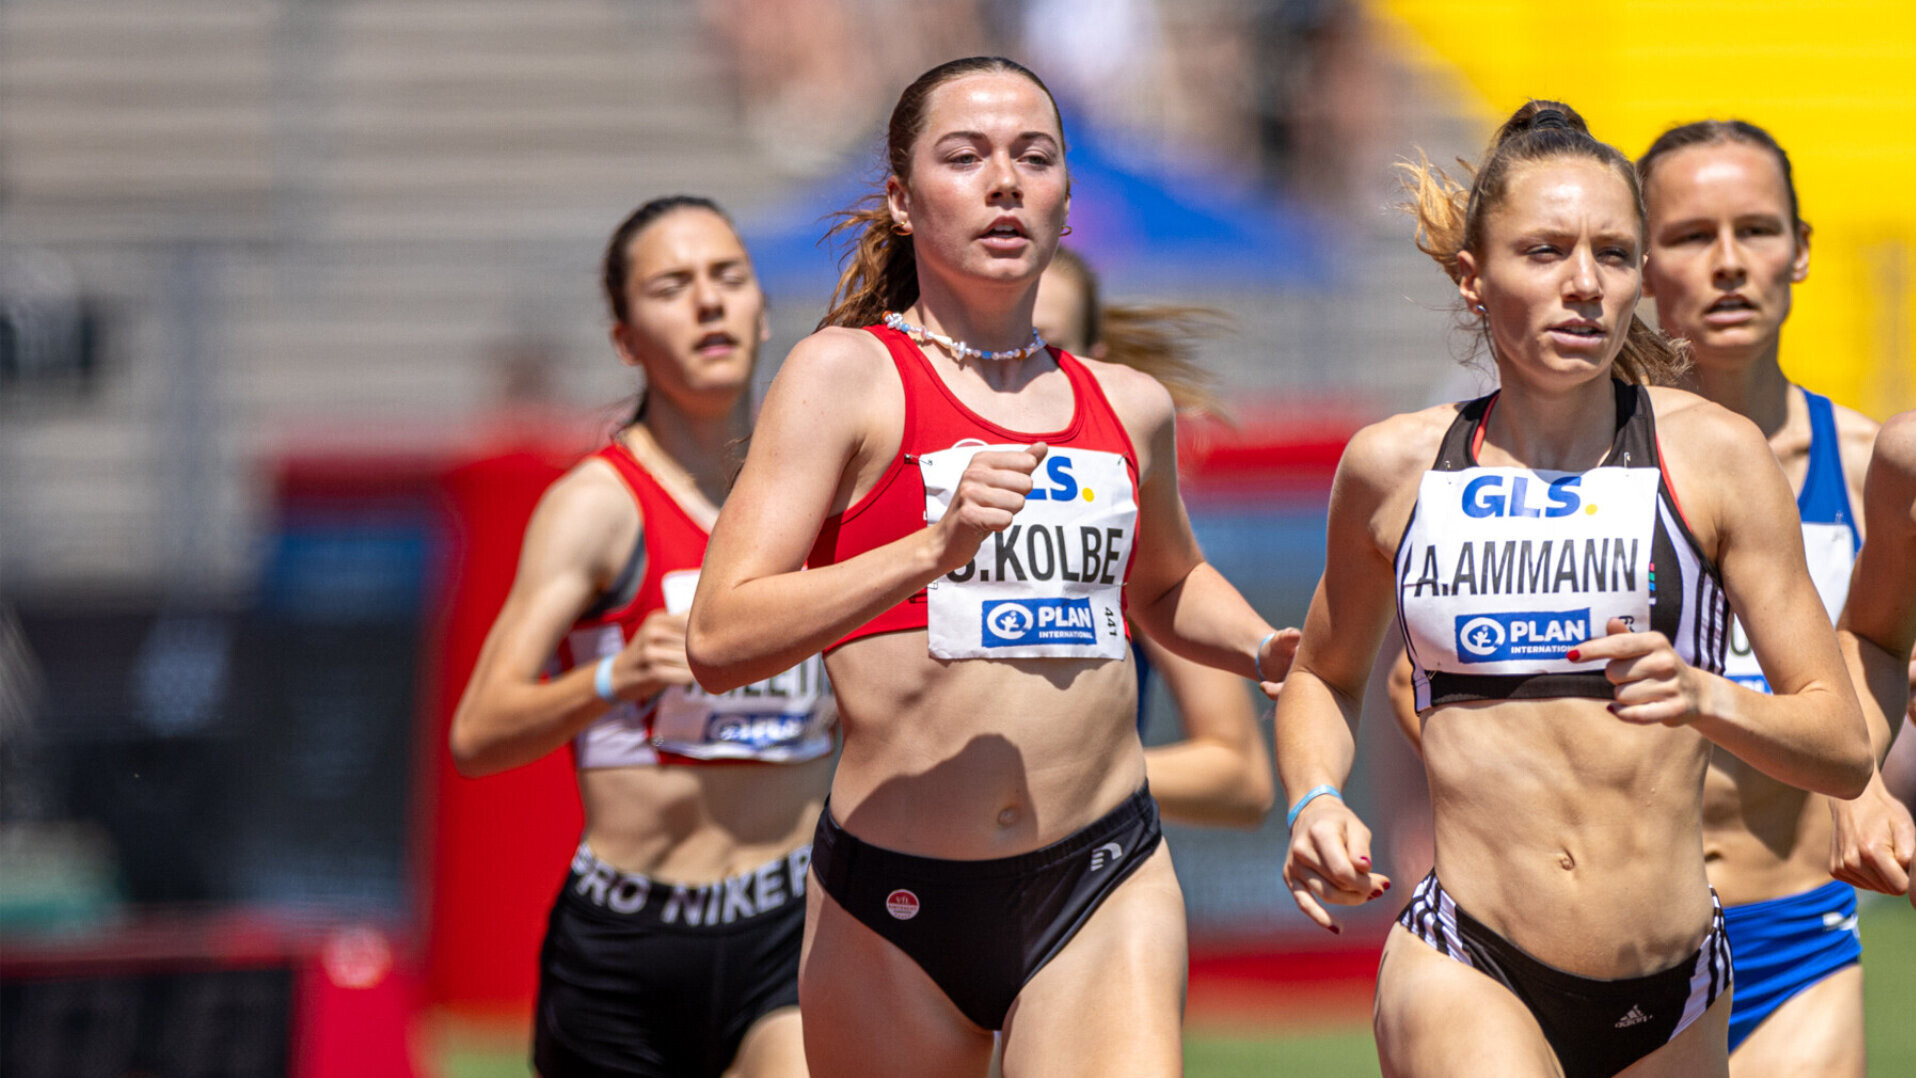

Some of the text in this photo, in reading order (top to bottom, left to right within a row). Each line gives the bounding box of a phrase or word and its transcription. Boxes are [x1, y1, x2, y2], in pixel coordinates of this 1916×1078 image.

[1461, 474, 1599, 519] GLS.
[1413, 537, 1639, 598] A.AMMANN
[1038, 606, 1092, 629] PLAN
[1510, 620, 1585, 642] PLAN
[571, 842, 651, 914] PRO
[660, 859, 787, 926] NIKE
